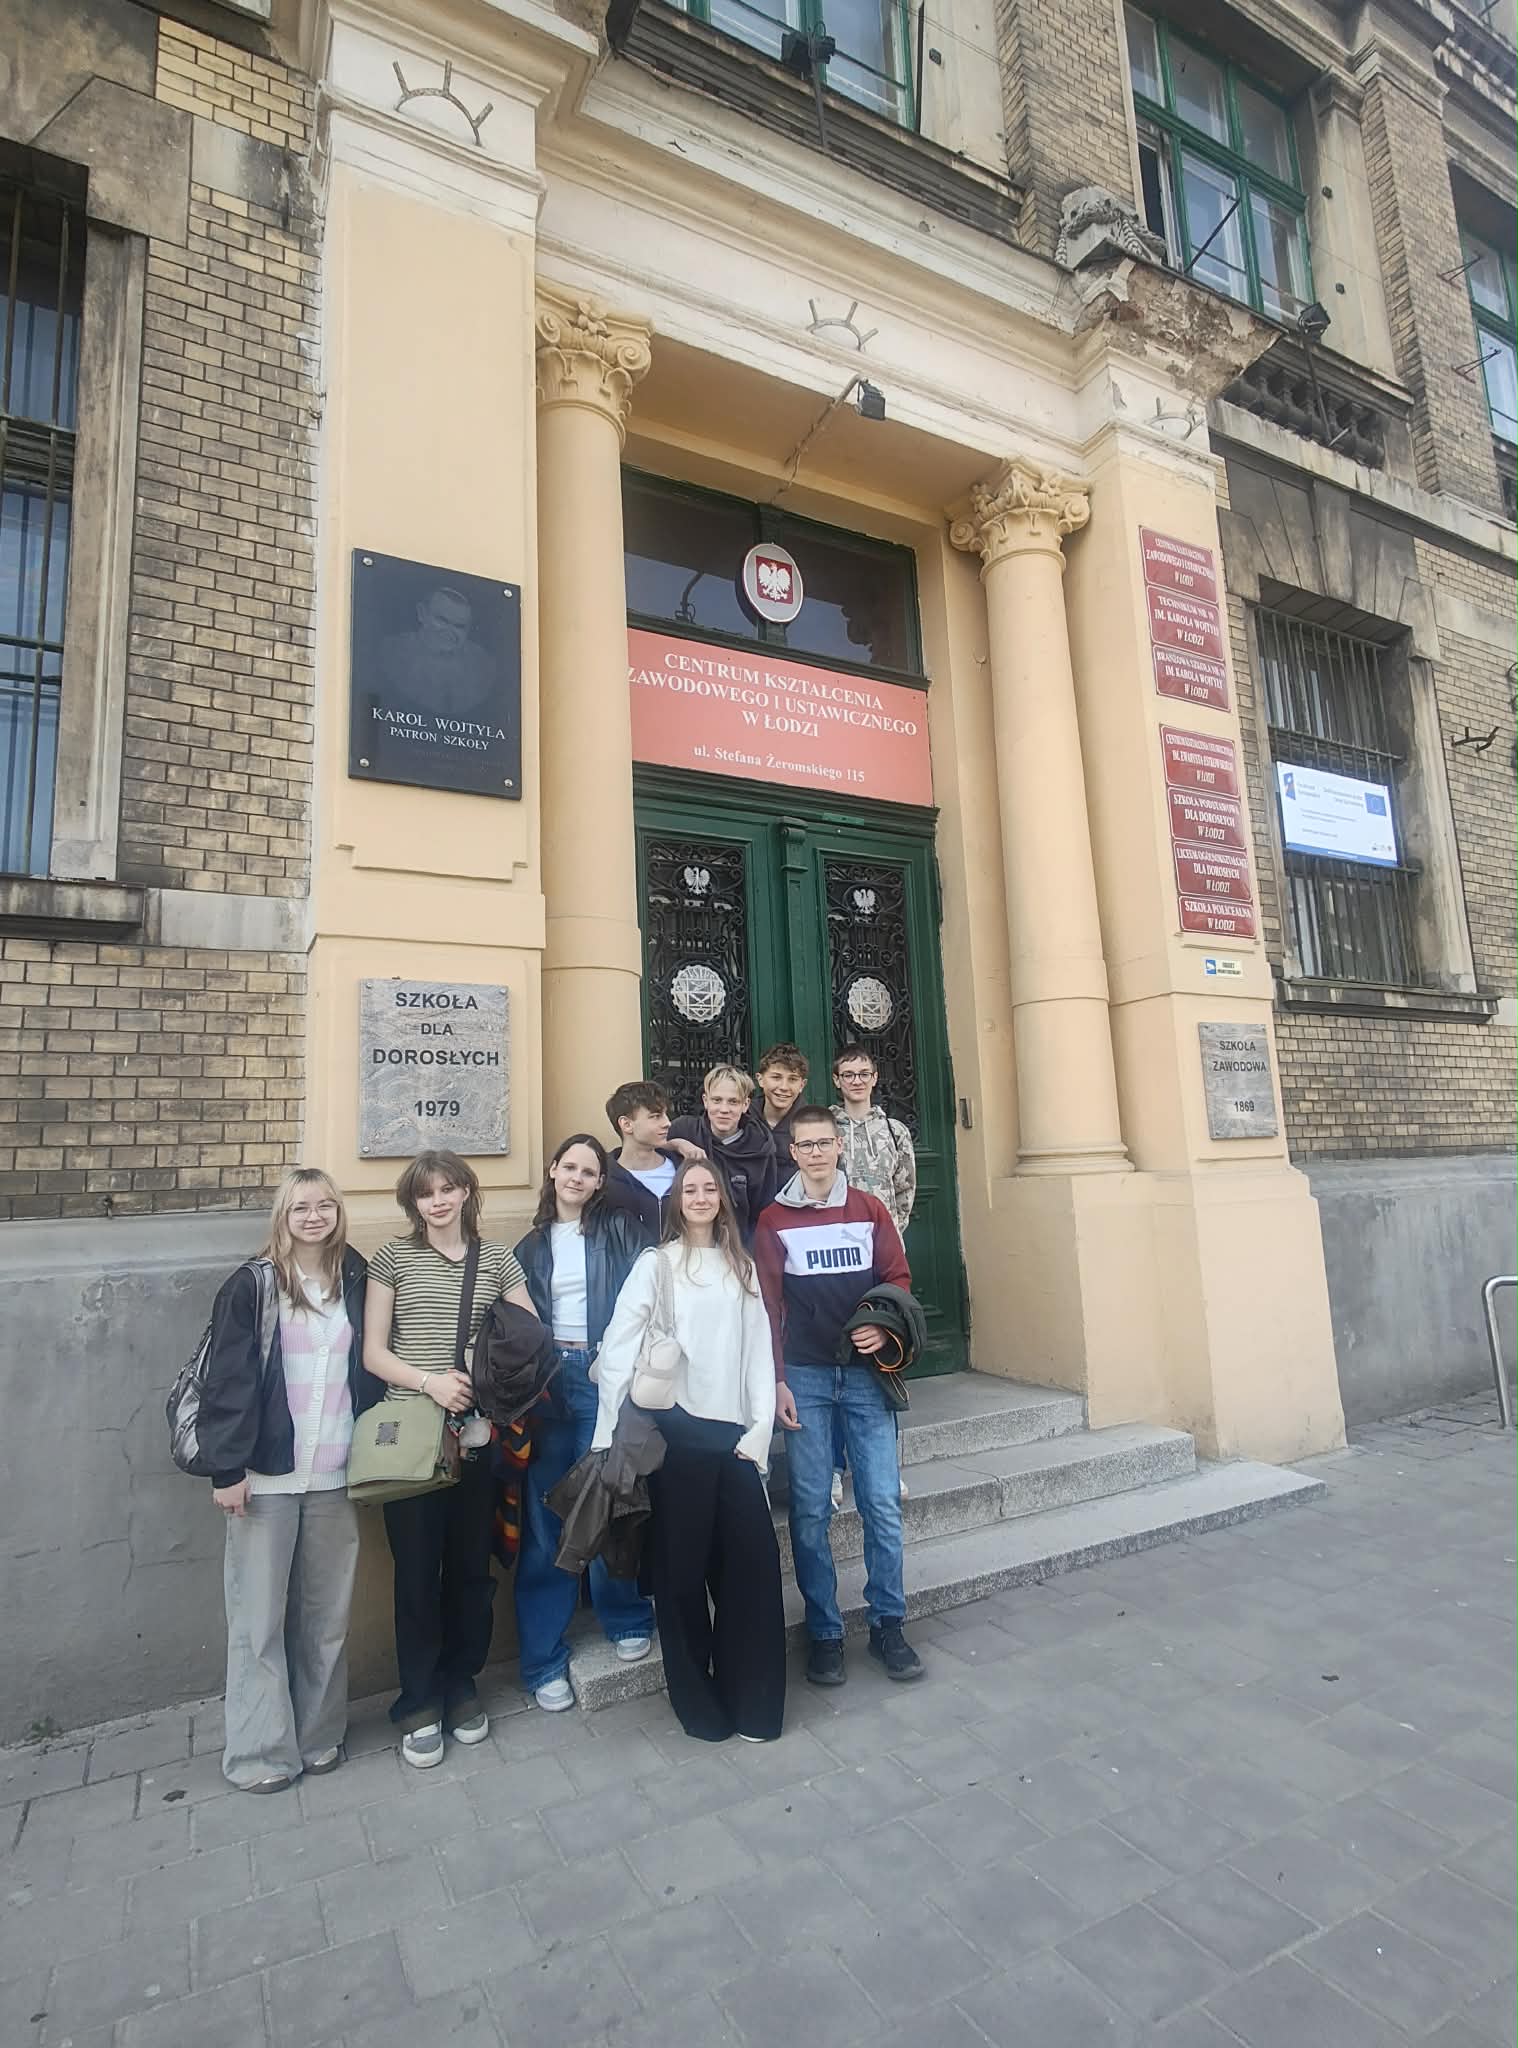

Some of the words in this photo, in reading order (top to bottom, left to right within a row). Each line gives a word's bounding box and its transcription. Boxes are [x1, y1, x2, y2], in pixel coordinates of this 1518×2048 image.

[1177, 628, 1183, 641] W
[665, 653, 759, 684] CENTRUM
[1184, 683, 1190, 695] W
[627, 667, 769, 707] ZAWODOWEGO
[774, 695, 779, 709] I
[786, 697, 917, 736] USTAWICZNEGO
[372, 707, 427, 727] KAROL
[742, 710, 759, 726] W
[764, 714, 819, 737] ŁODZI
[390, 726, 437, 742] PATRON
[443, 735, 489, 750] SZKOŁY
[694, 744, 710, 757] ul.
[714, 747, 761, 766] Stefana
[766, 753, 842, 781] Żeromskiego
[847, 768, 865, 783] 115
[1184, 808, 1198, 820] DLA
[1197, 825, 1204, 837] W
[1205, 826, 1225, 840] ŁODZI
[1193, 863, 1206, 875] DLA
[1205, 879, 1211, 890] W
[1184, 900, 1212, 914] SZKOŁA
[1207, 917, 1213, 929] W
[1214, 918, 1235, 931] ŁODZI
[395, 992, 478, 1010] SZKOŁA
[421, 1023, 454, 1035] DLA
[1219, 1040, 1256, 1051] SZKOŁA
[373, 1049, 499, 1066] DOROSŁYCH
[1213, 1060, 1267, 1072] ZAWODOWA
[414, 1100, 460, 1117] 1979
[1234, 1100, 1255, 1113] 1869
[806, 1246, 862, 1270] PUMA
